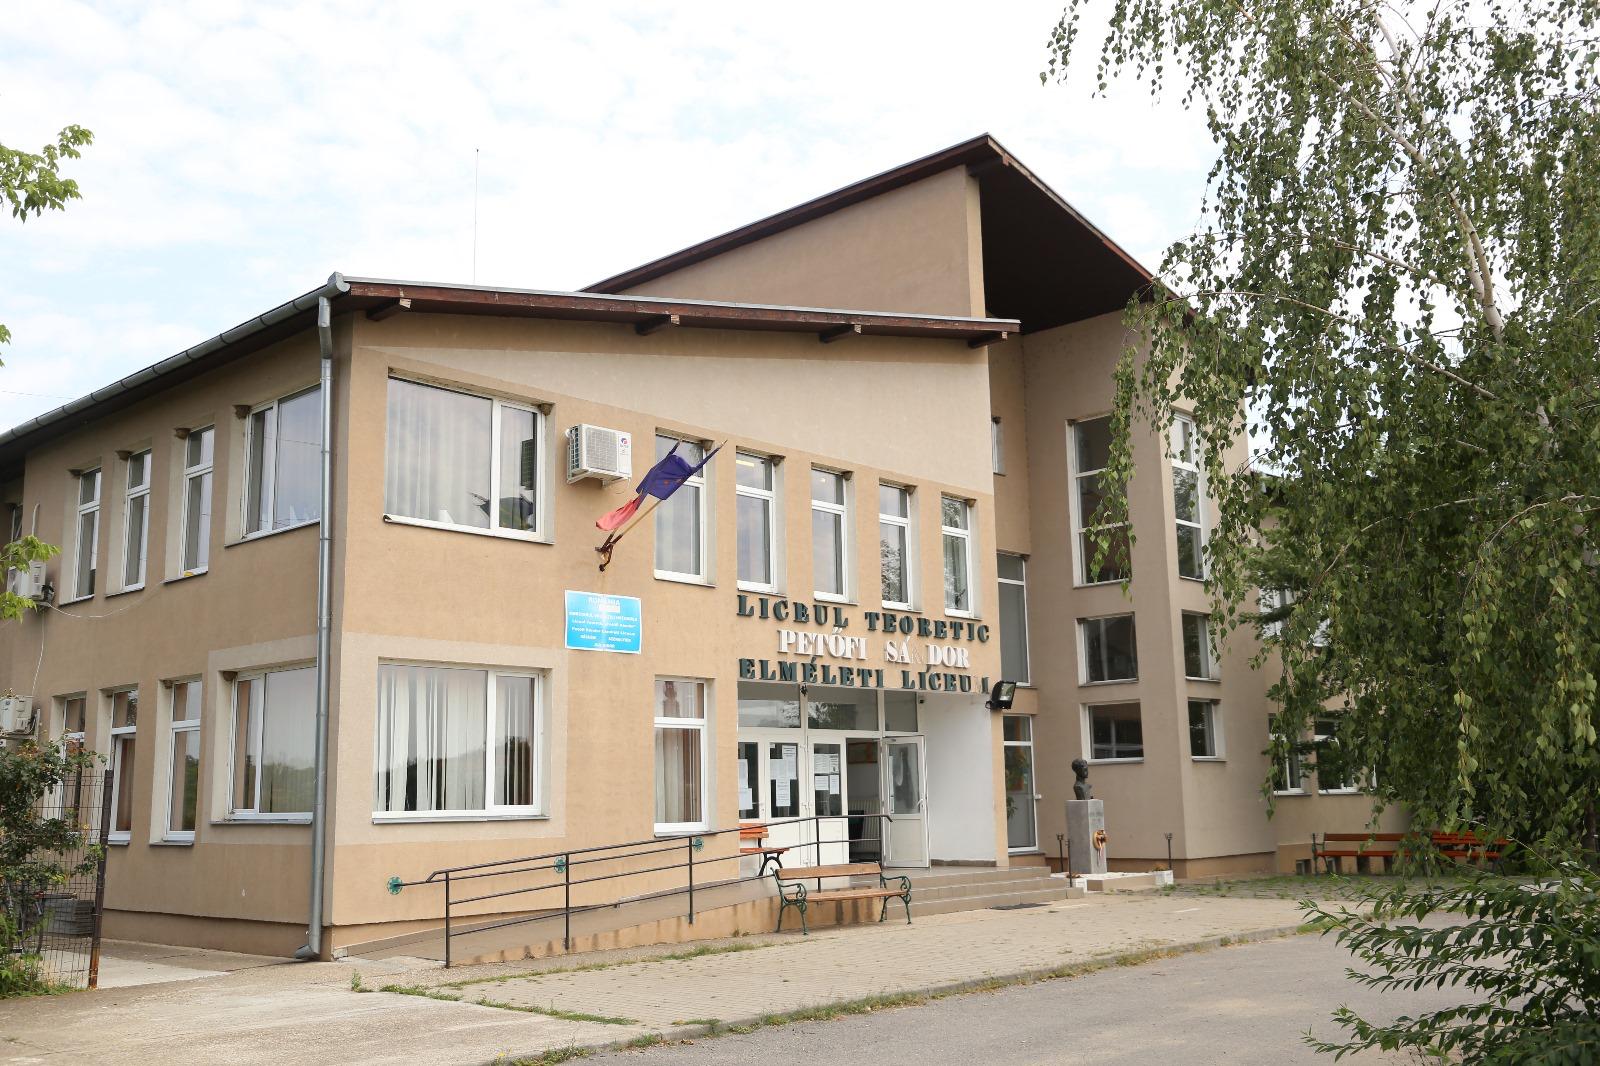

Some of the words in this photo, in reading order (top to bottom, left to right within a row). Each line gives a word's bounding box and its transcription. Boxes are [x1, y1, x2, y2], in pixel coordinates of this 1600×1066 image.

[865, 611, 990, 643] TEORETIC
[777, 627, 868, 660] PETŐFI
[886, 636, 970, 668] SÁDOR
[738, 656, 885, 688] ELMÉLETI
